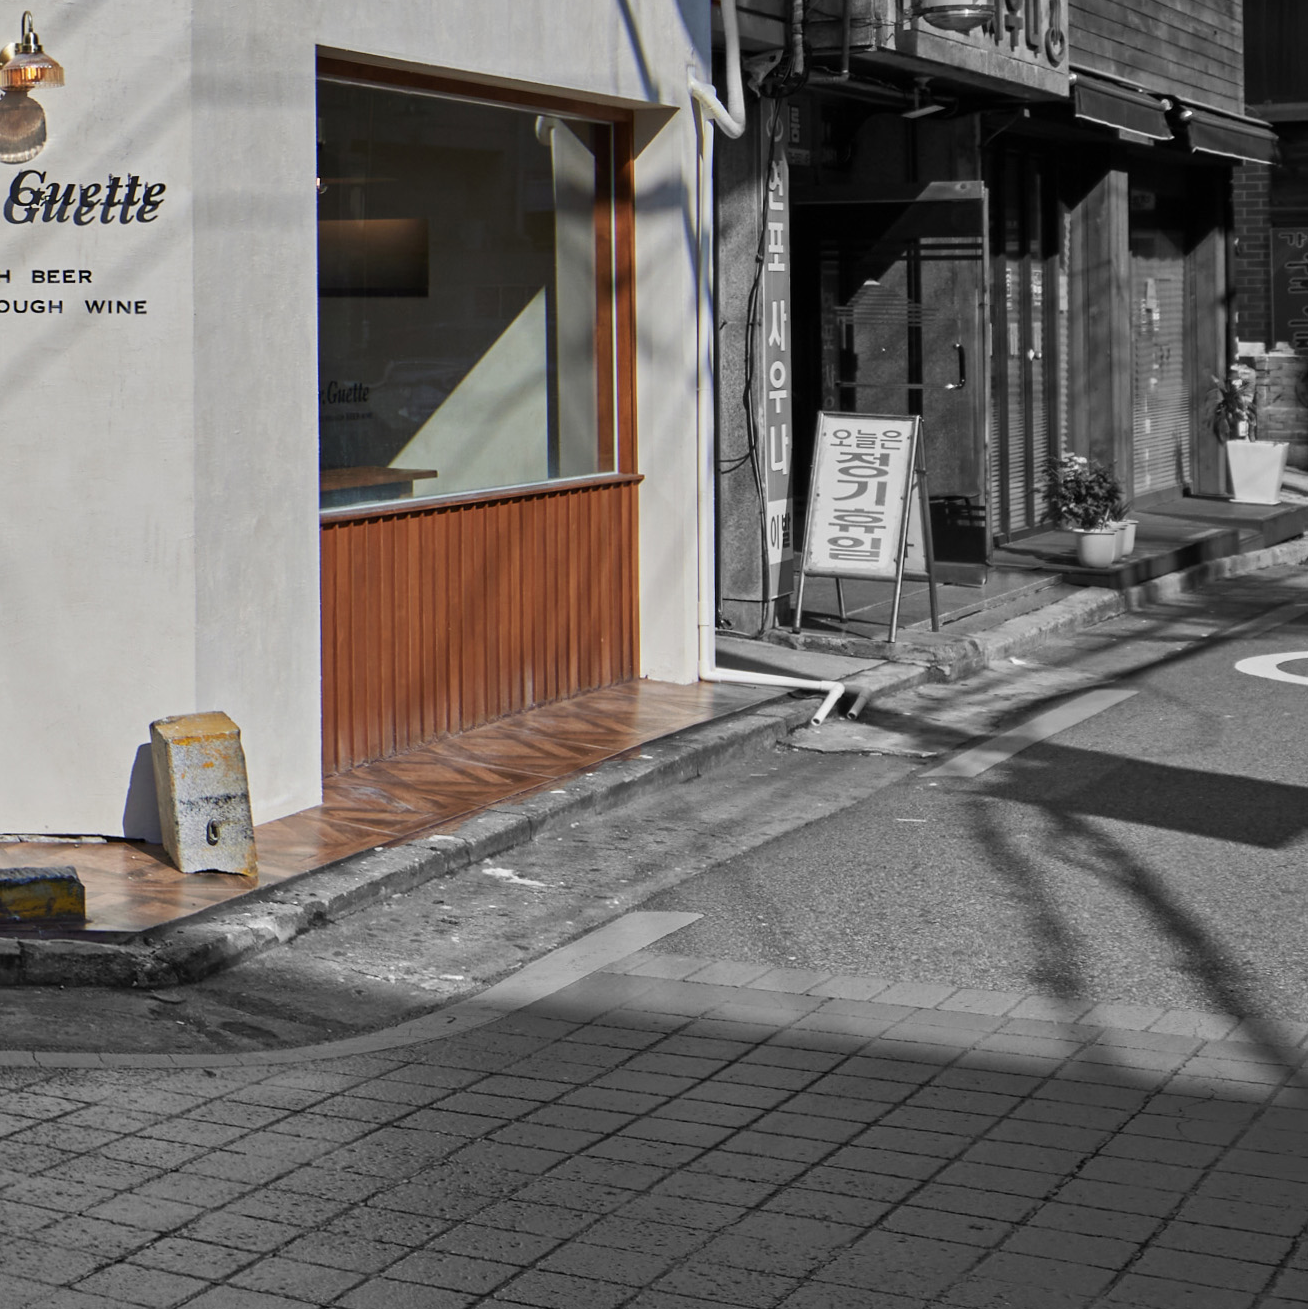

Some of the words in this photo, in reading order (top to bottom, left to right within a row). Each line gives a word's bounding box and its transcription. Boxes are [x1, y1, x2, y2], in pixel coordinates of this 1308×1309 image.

[768, 160, 785, 271] 연포
[32, 269, 93, 284] BEER
[85, 299, 148, 315] WINE
[769, 300, 789, 475] 사우나
[830, 429, 902, 451] 오늘은
[827, 452, 890, 562] 정기휴일
[770, 512, 791, 550] 이발
